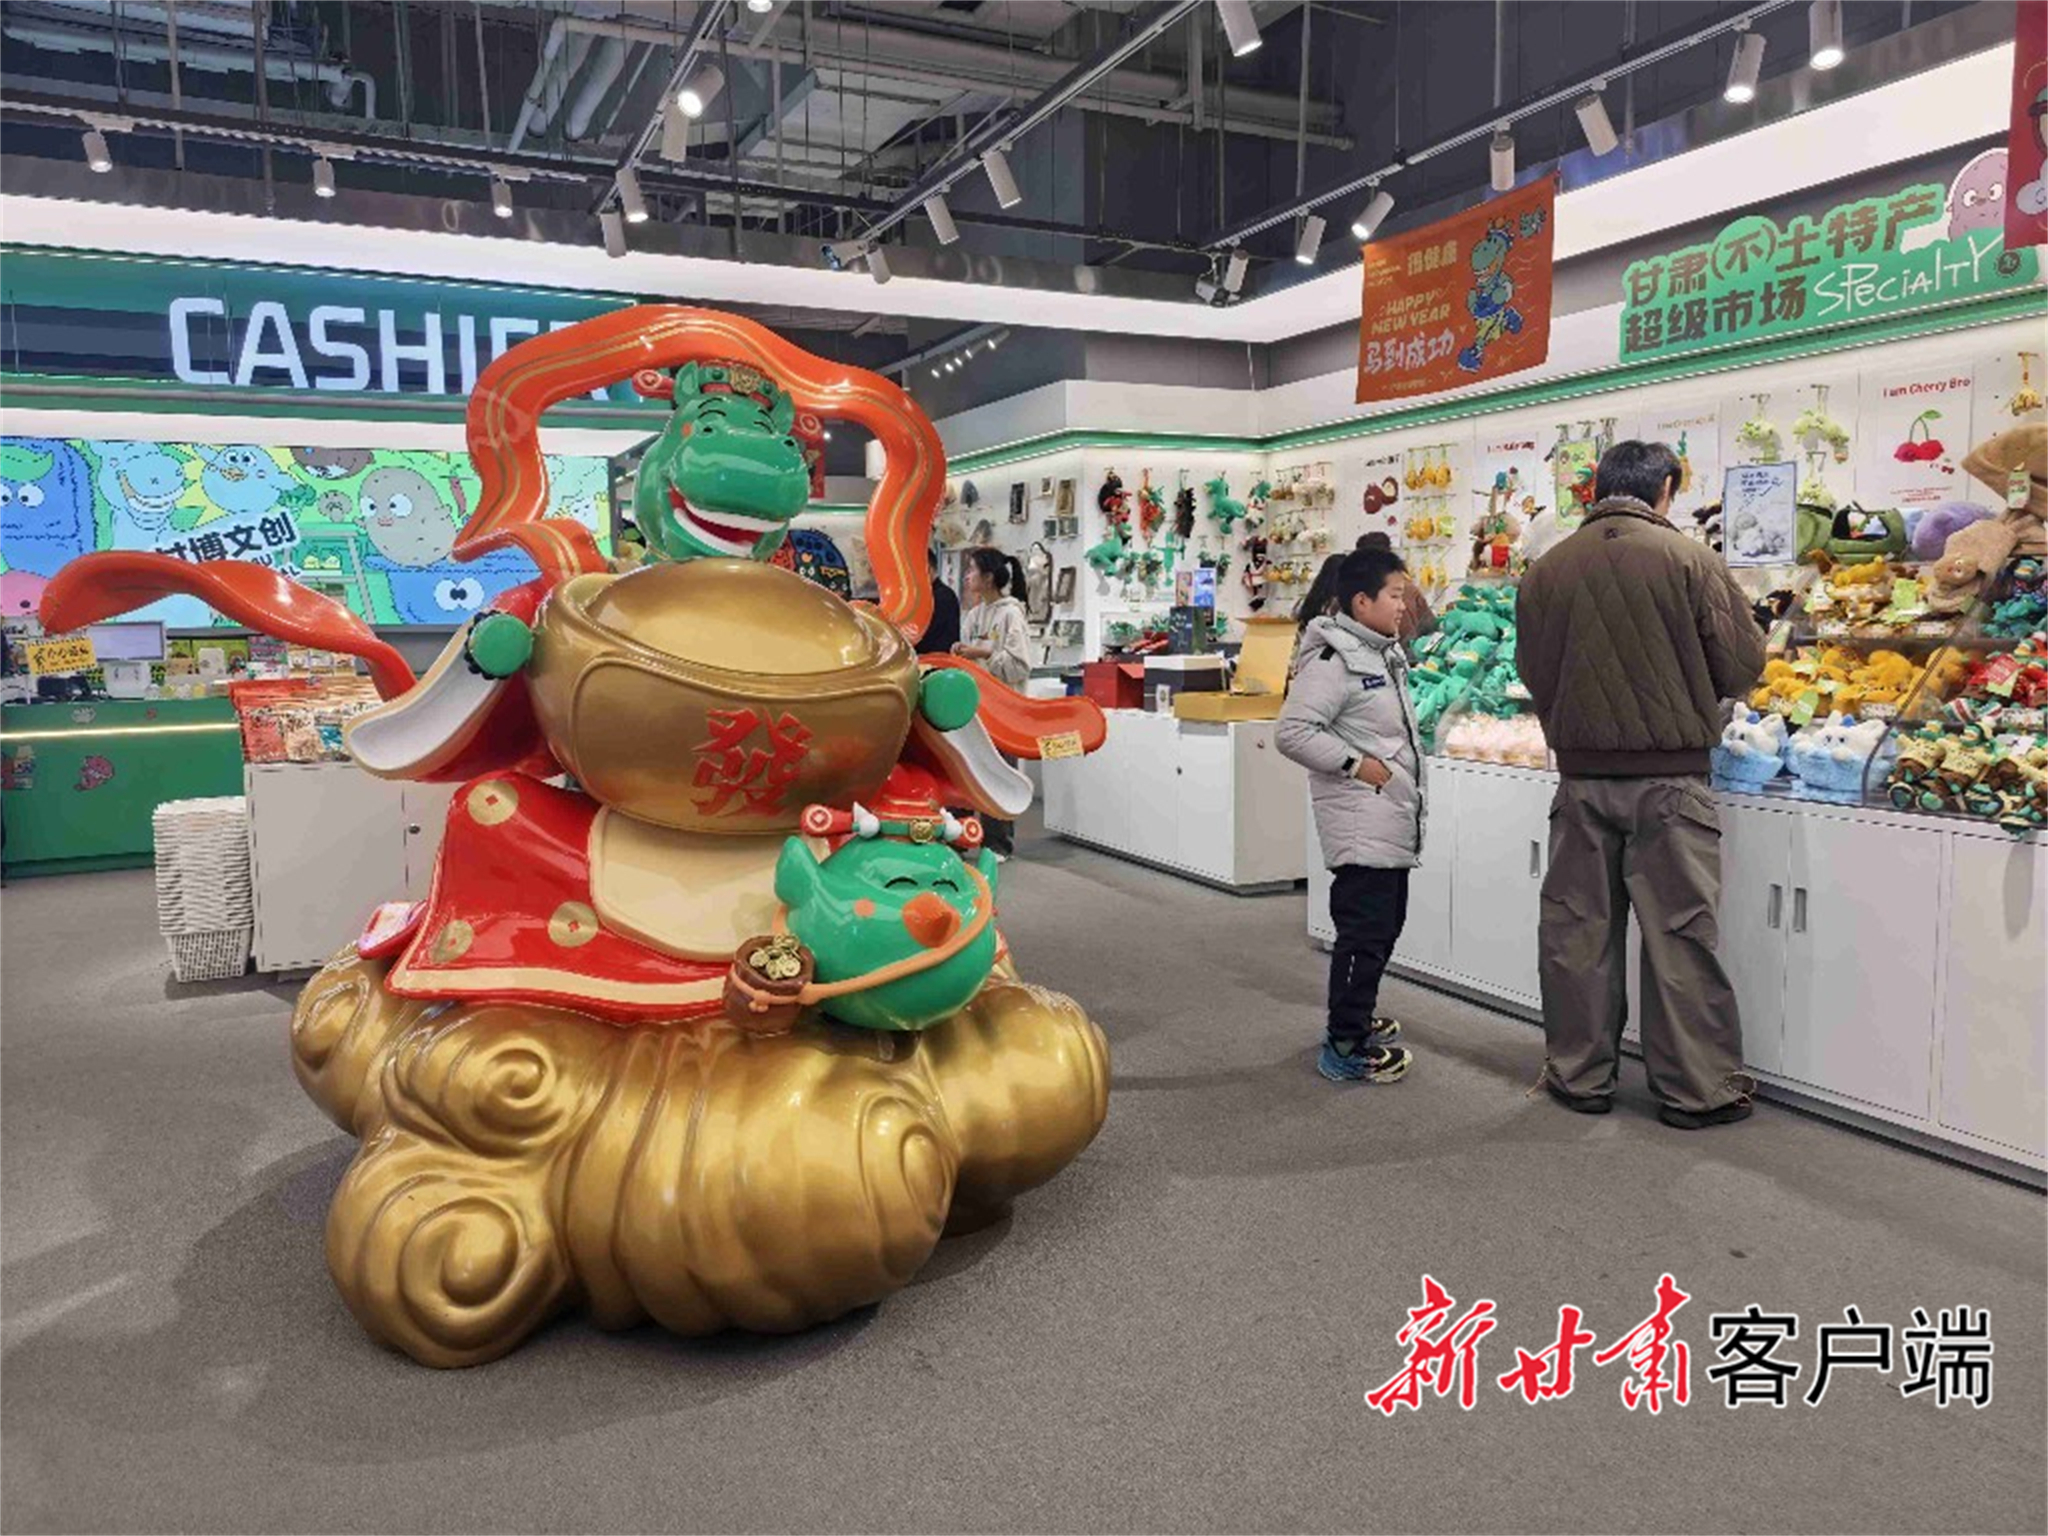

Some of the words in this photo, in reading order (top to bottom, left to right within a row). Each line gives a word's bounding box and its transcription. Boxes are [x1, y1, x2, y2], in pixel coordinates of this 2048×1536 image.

[1386, 290, 1438, 315] HAPPY
[1624, 276, 1807, 355] 超级市场
[1371, 313, 1407, 335] NEW
[1409, 303, 1450, 327] YEAR
[169, 296, 613, 402] CASHI
[1949, 377, 1971, 389] Bro
